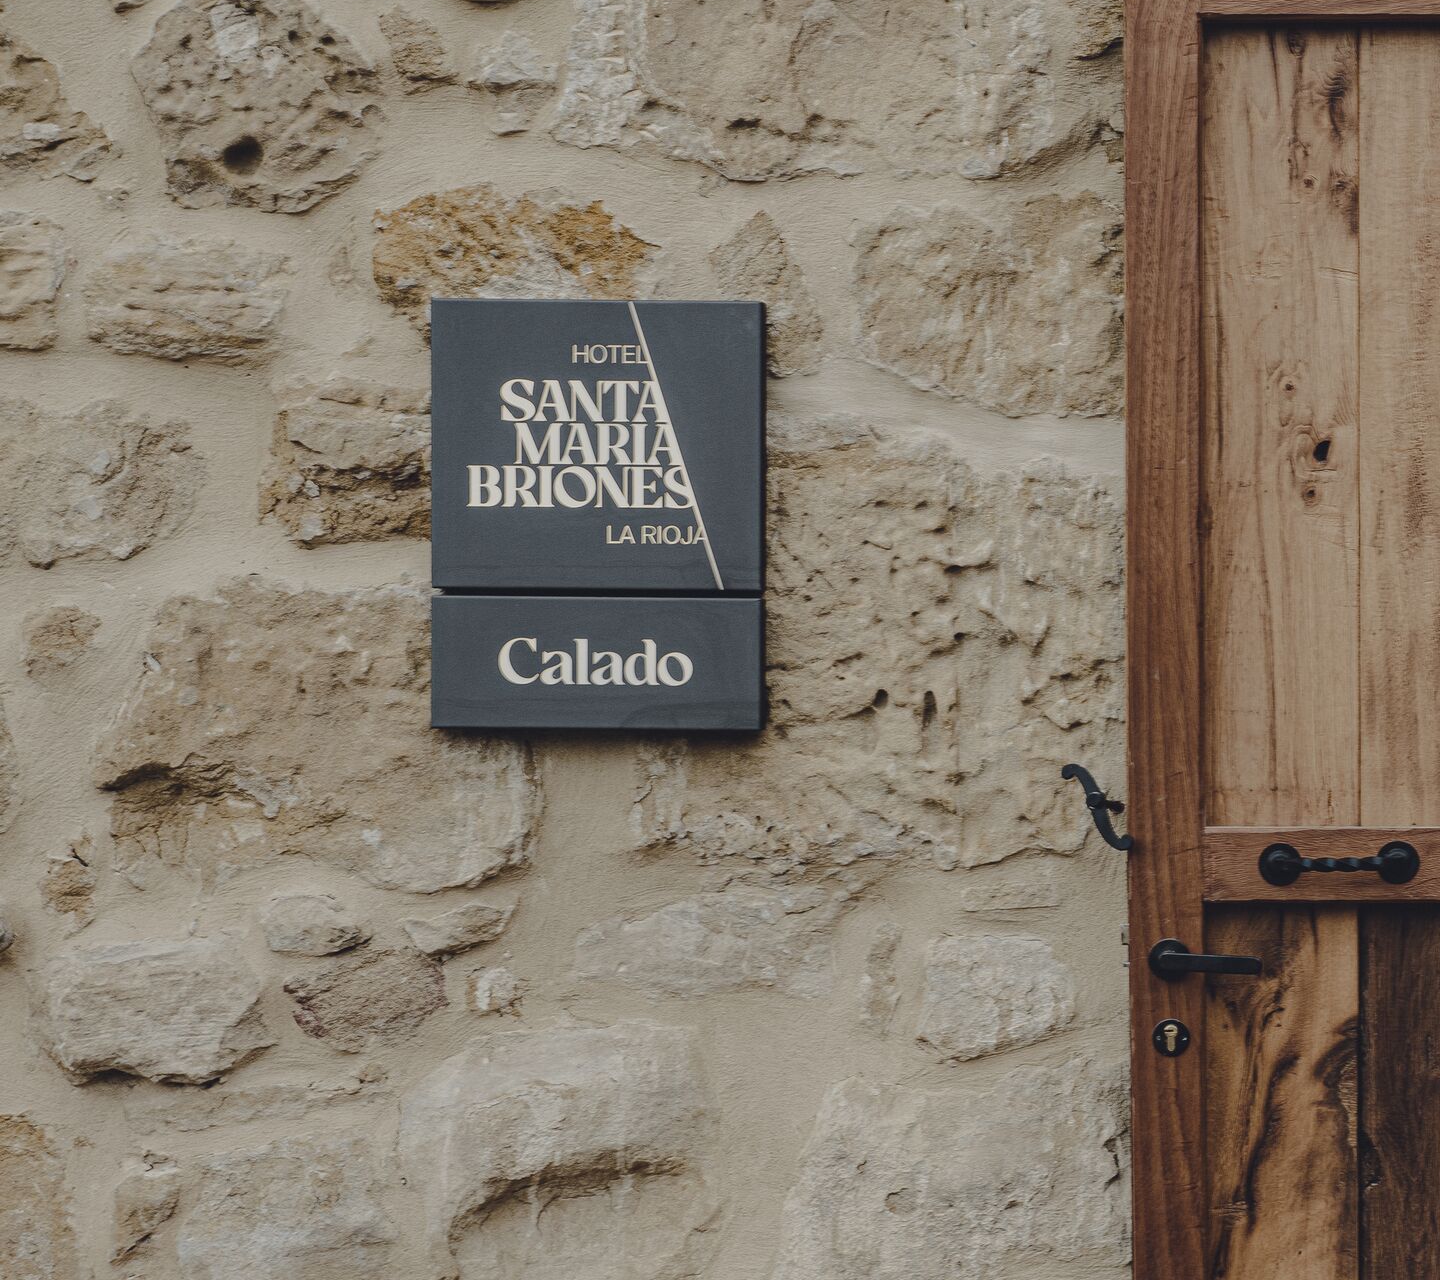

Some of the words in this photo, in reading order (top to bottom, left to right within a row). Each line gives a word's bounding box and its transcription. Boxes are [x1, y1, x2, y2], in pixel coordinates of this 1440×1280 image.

[571, 344, 650, 365] HOTEL
[499, 378, 670, 423] SANTA
[512, 422, 682, 466] MARIA
[466, 464, 695, 509] BRIONES
[605, 525, 636, 546] LA
[640, 525, 709, 546] RIOJA
[497, 636, 694, 687] Calado
